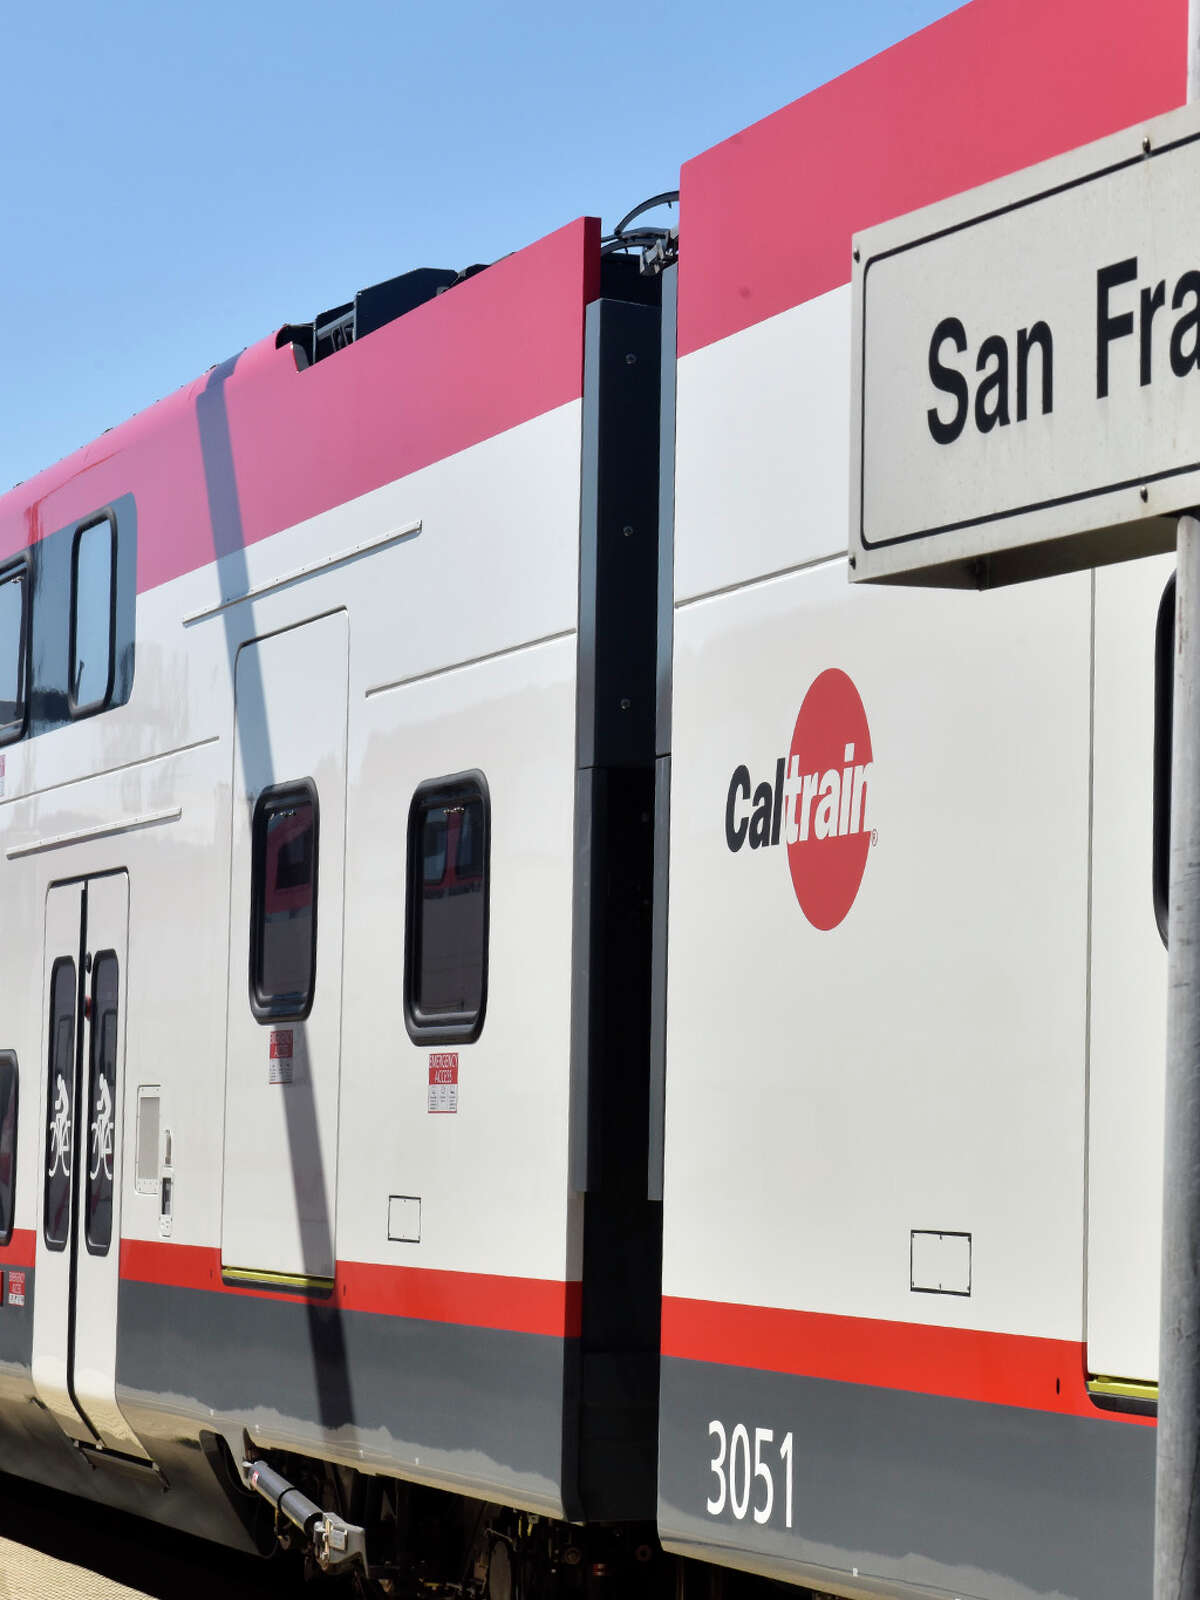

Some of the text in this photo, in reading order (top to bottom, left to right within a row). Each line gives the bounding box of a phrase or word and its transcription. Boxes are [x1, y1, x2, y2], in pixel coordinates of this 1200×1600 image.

[927, 317, 1053, 445] San
[725, 743, 873, 853] Caltrain
[707, 1420, 793, 1528] 3051
